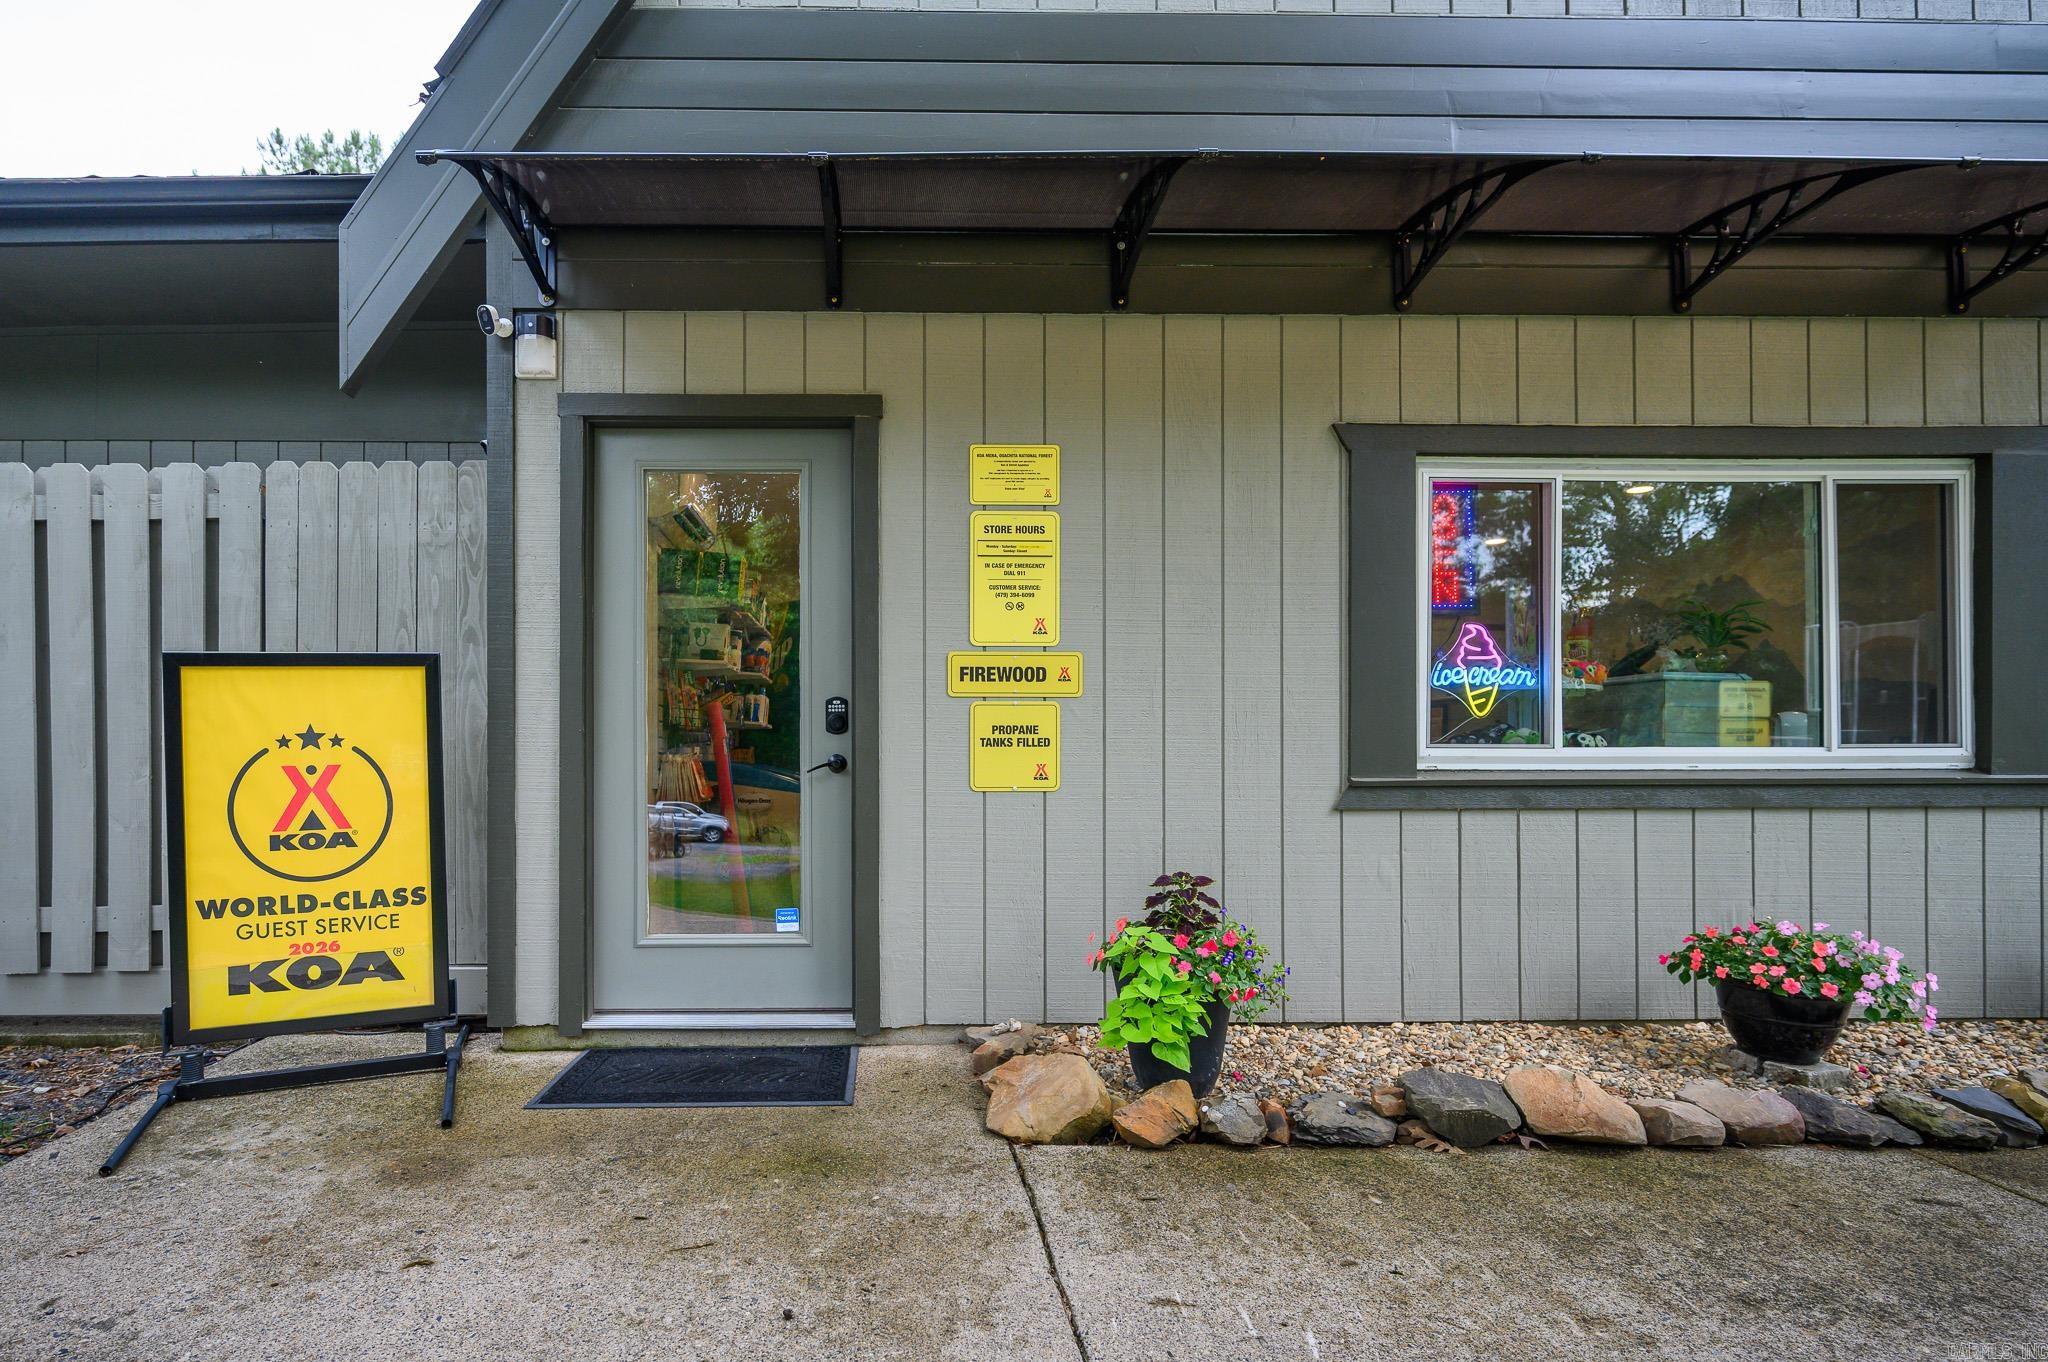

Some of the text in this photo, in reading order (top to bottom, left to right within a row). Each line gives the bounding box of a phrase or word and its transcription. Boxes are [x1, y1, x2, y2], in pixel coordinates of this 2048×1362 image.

[983, 525, 1045, 535] STORE HOURS
[959, 666, 1047, 682] FIREWOOD
[1432, 662, 1538, 686] ice cream
[991, 725, 1039, 735] PROPANE
[980, 737, 1051, 748] TANKS FILLED
[195, 886, 427, 920] WORLD-CLASS
[235, 913, 400, 940] GUEST SERVICE
[288, 940, 341, 956] 2026
